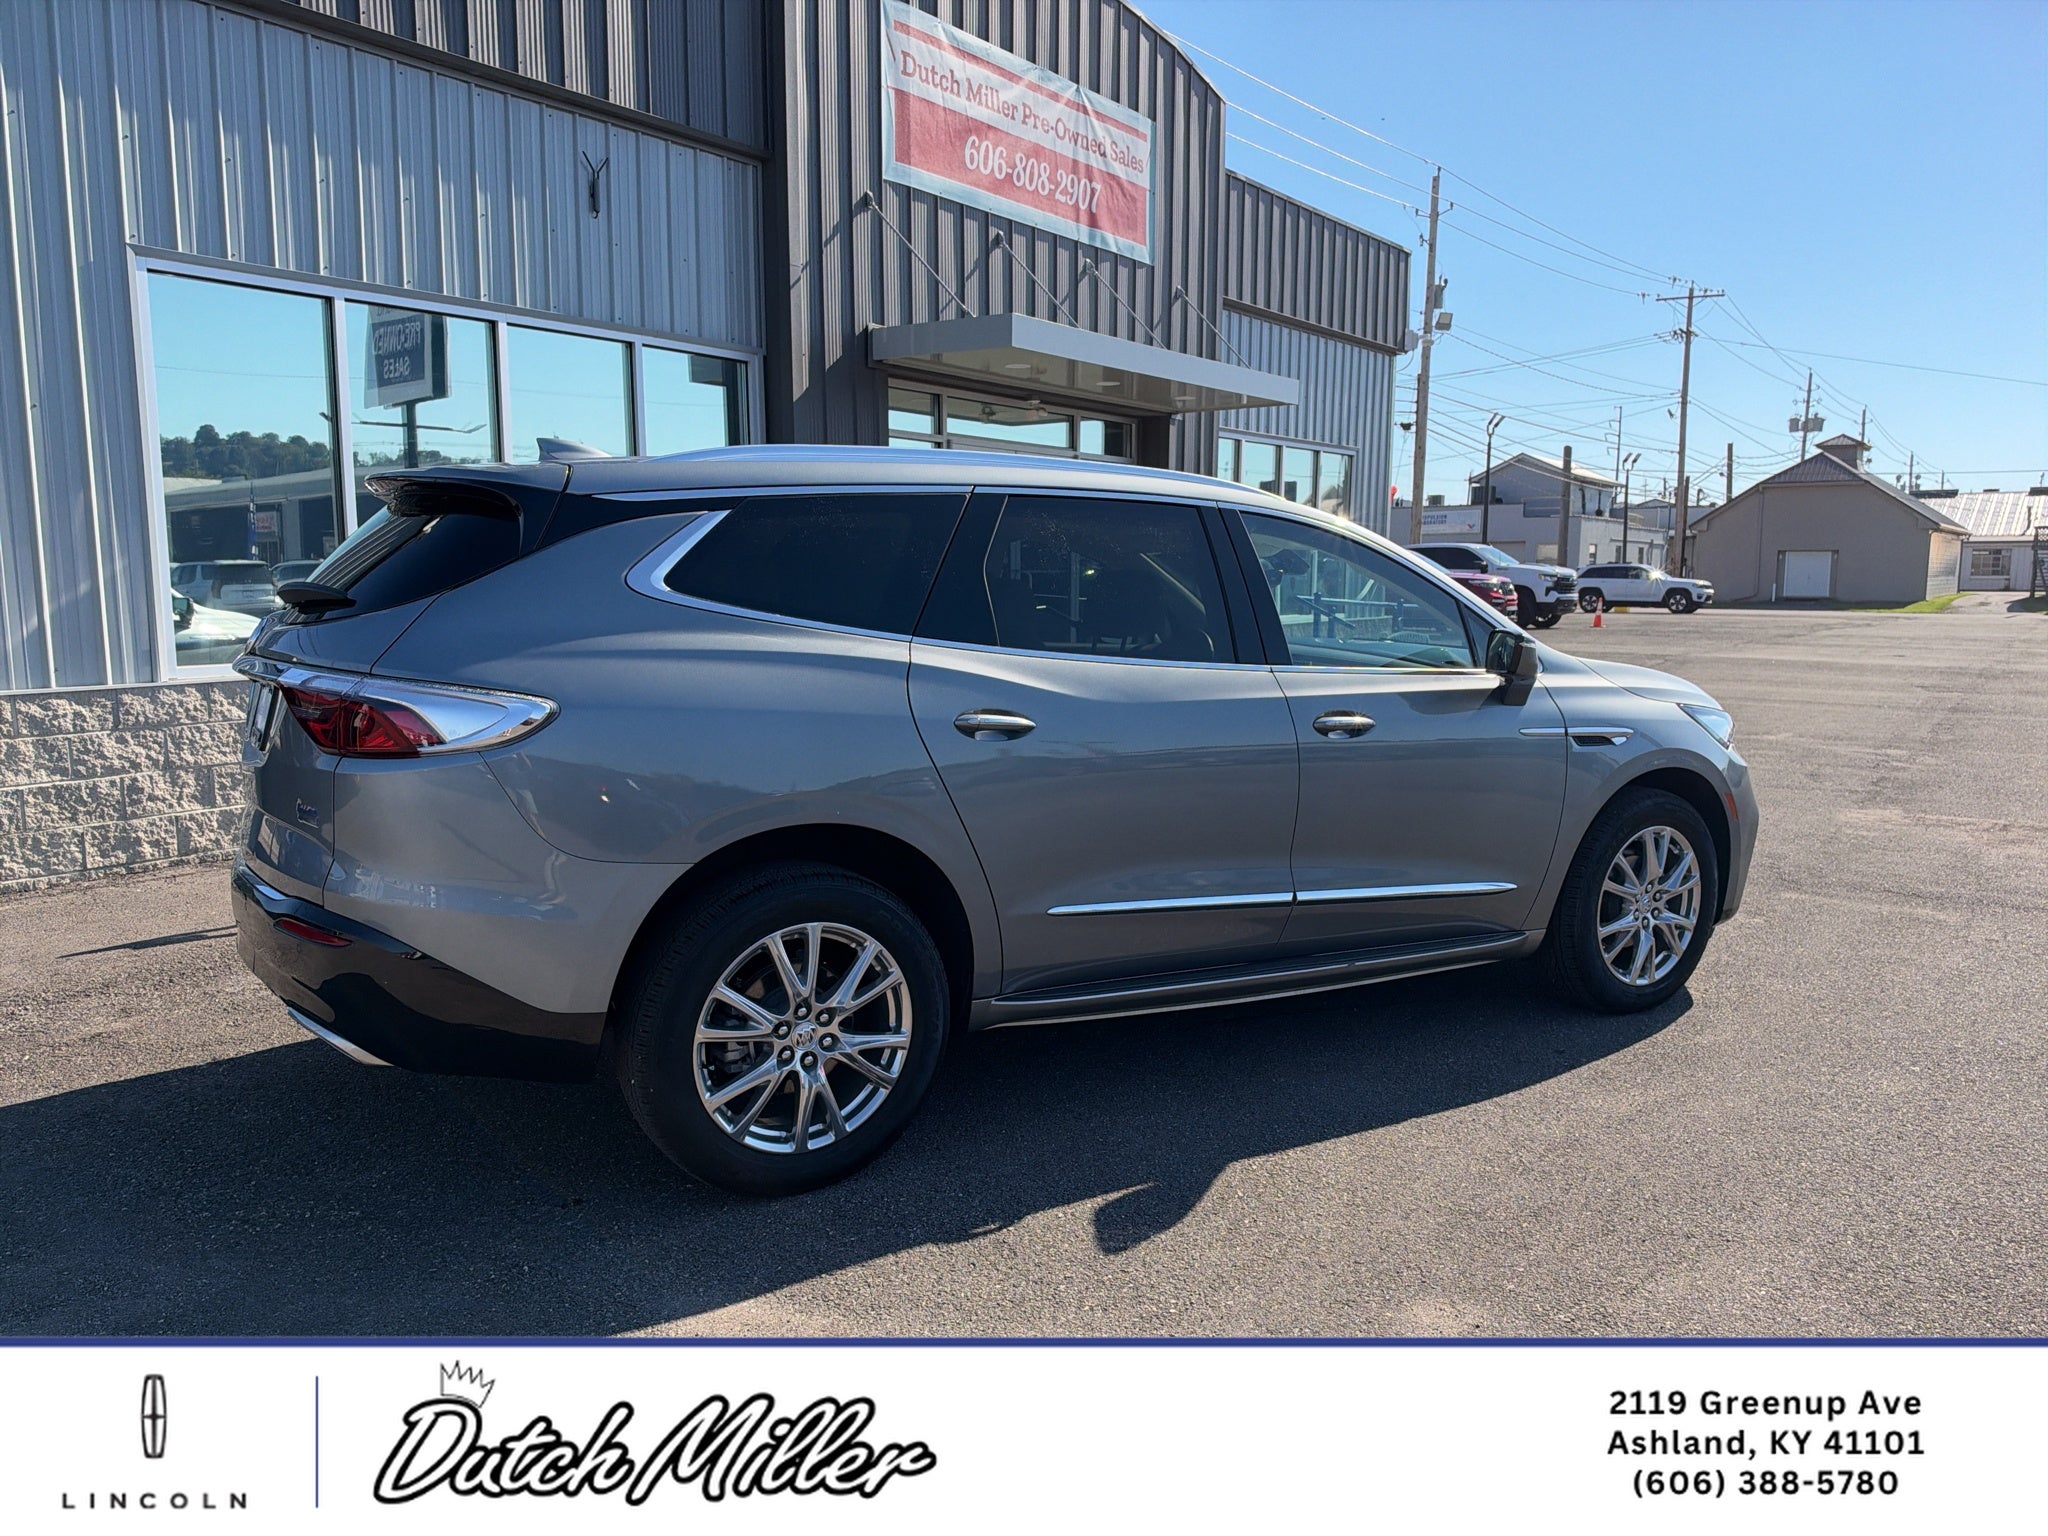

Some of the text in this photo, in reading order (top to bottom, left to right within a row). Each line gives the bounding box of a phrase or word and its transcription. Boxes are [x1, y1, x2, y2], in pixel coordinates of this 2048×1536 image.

[900, 51, 1144, 174] Dutch Miller Pre-Owned Sales
[965, 135, 1101, 213] 606-808-2907
